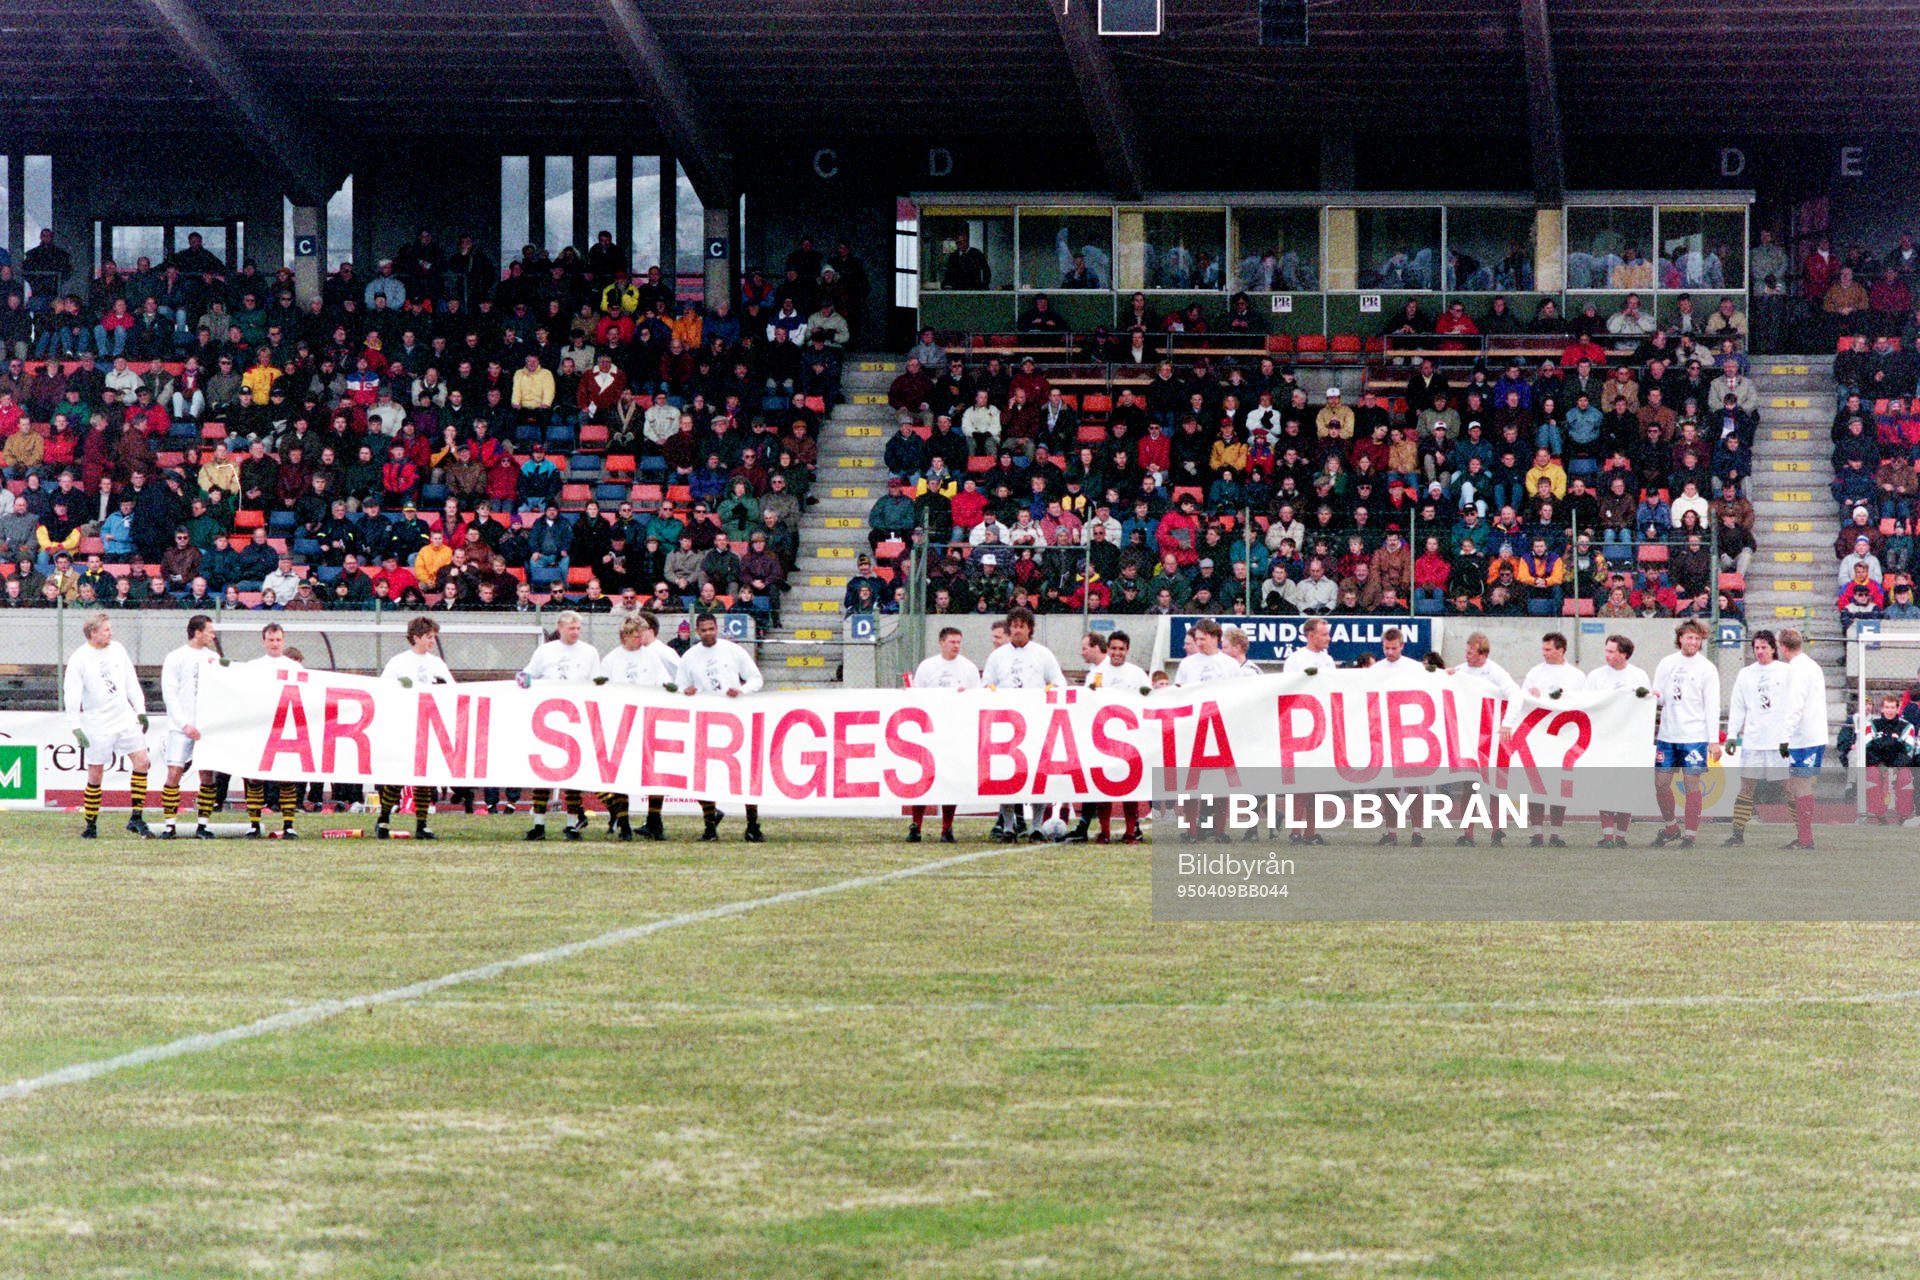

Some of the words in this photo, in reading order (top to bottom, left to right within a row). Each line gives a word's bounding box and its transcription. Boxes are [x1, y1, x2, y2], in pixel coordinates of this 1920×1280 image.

[813, 148, 839, 178] C
[929, 148, 953, 177] D
[1721, 147, 1746, 176] D
[1841, 146, 1863, 175] E
[299, 239, 312, 255] C
[710, 242, 723, 257] C
[729, 620, 742, 636] C
[857, 620, 871, 636] D
[1722, 629, 1736, 645] D
[258, 669, 375, 776] ÄR
[413, 692, 491, 779] NI
[528, 697, 936, 799] SVERIGES
[976, 689, 1242, 798] BÄSTA
[1276, 688, 1593, 799] PUBLIK?
